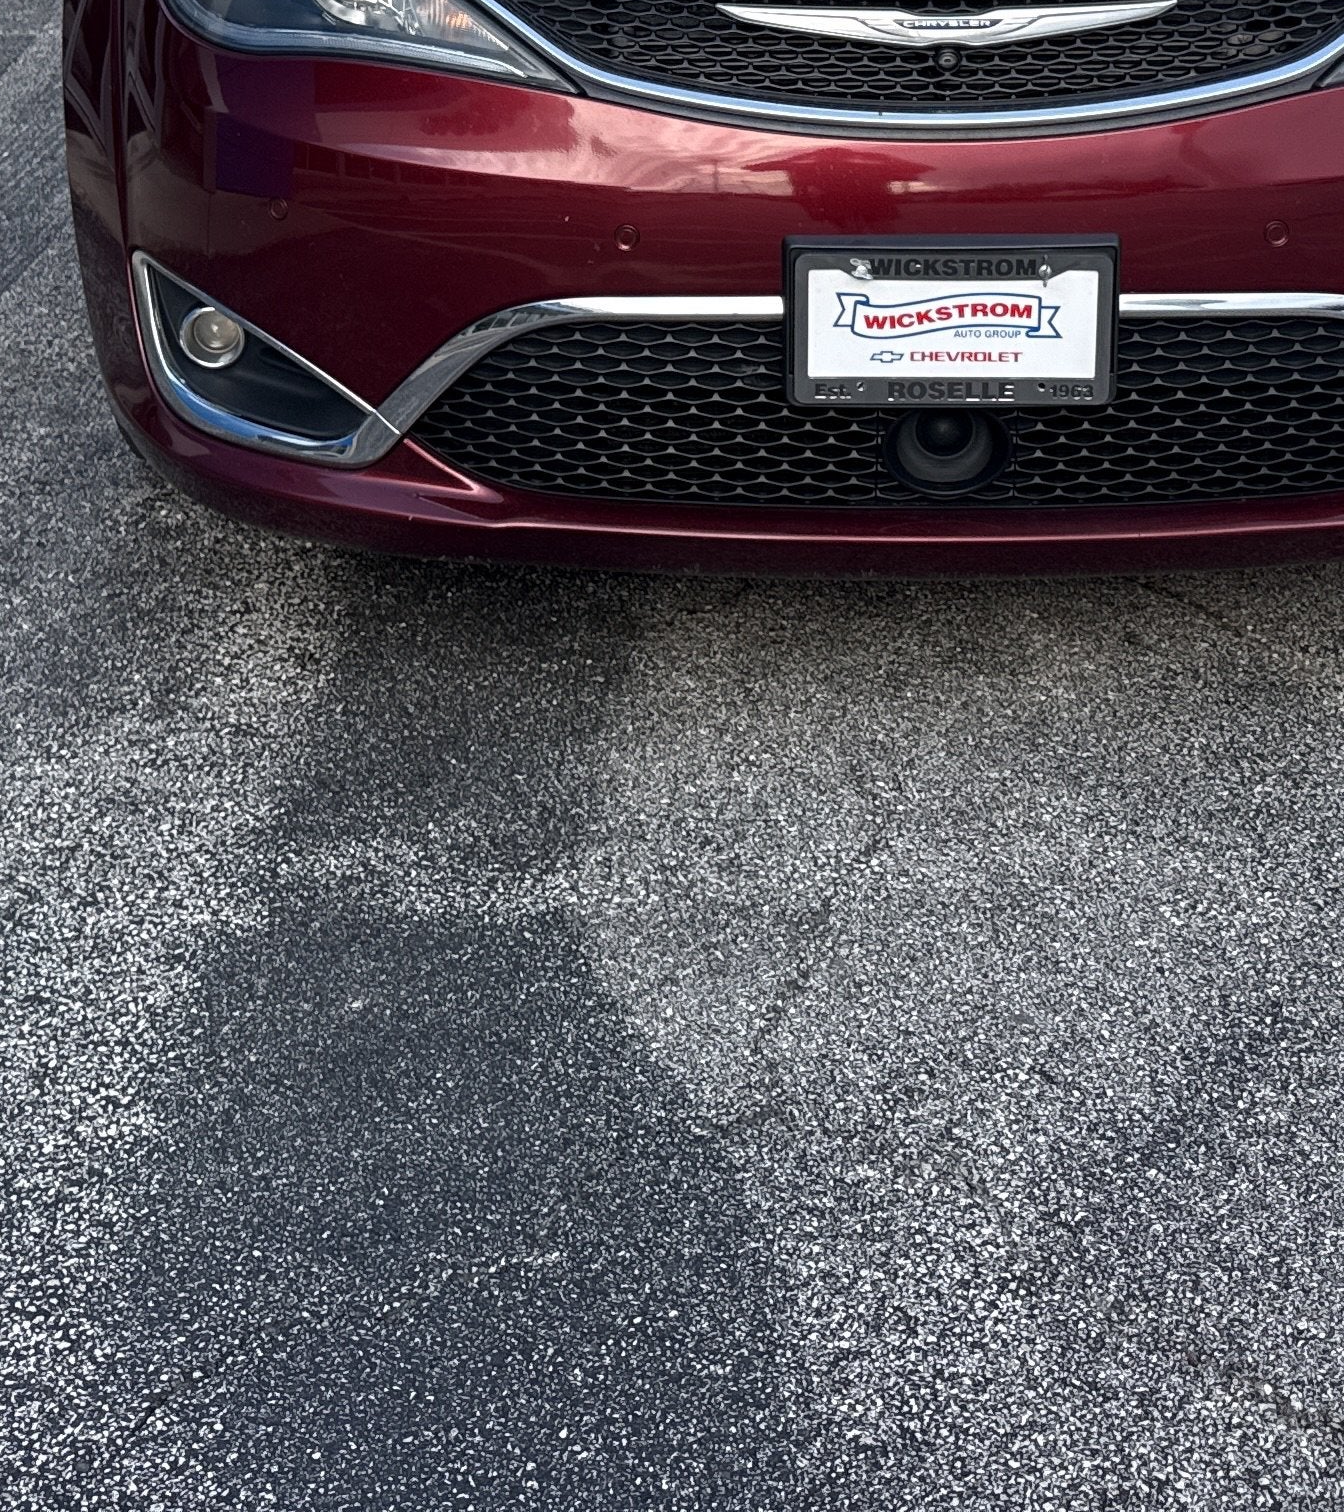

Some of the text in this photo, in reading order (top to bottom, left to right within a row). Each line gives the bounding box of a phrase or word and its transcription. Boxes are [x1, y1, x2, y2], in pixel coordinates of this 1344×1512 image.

[902, 19, 991, 28] CHRYSLER
[868, 258, 1037, 277] WICKSTROM
[863, 302, 1033, 330] WICKSTROM
[953, 329, 1022, 339] AUTO GROUP
[909, 350, 1023, 363] CHEVROLET
[887, 381, 1015, 402] ROSELLE
